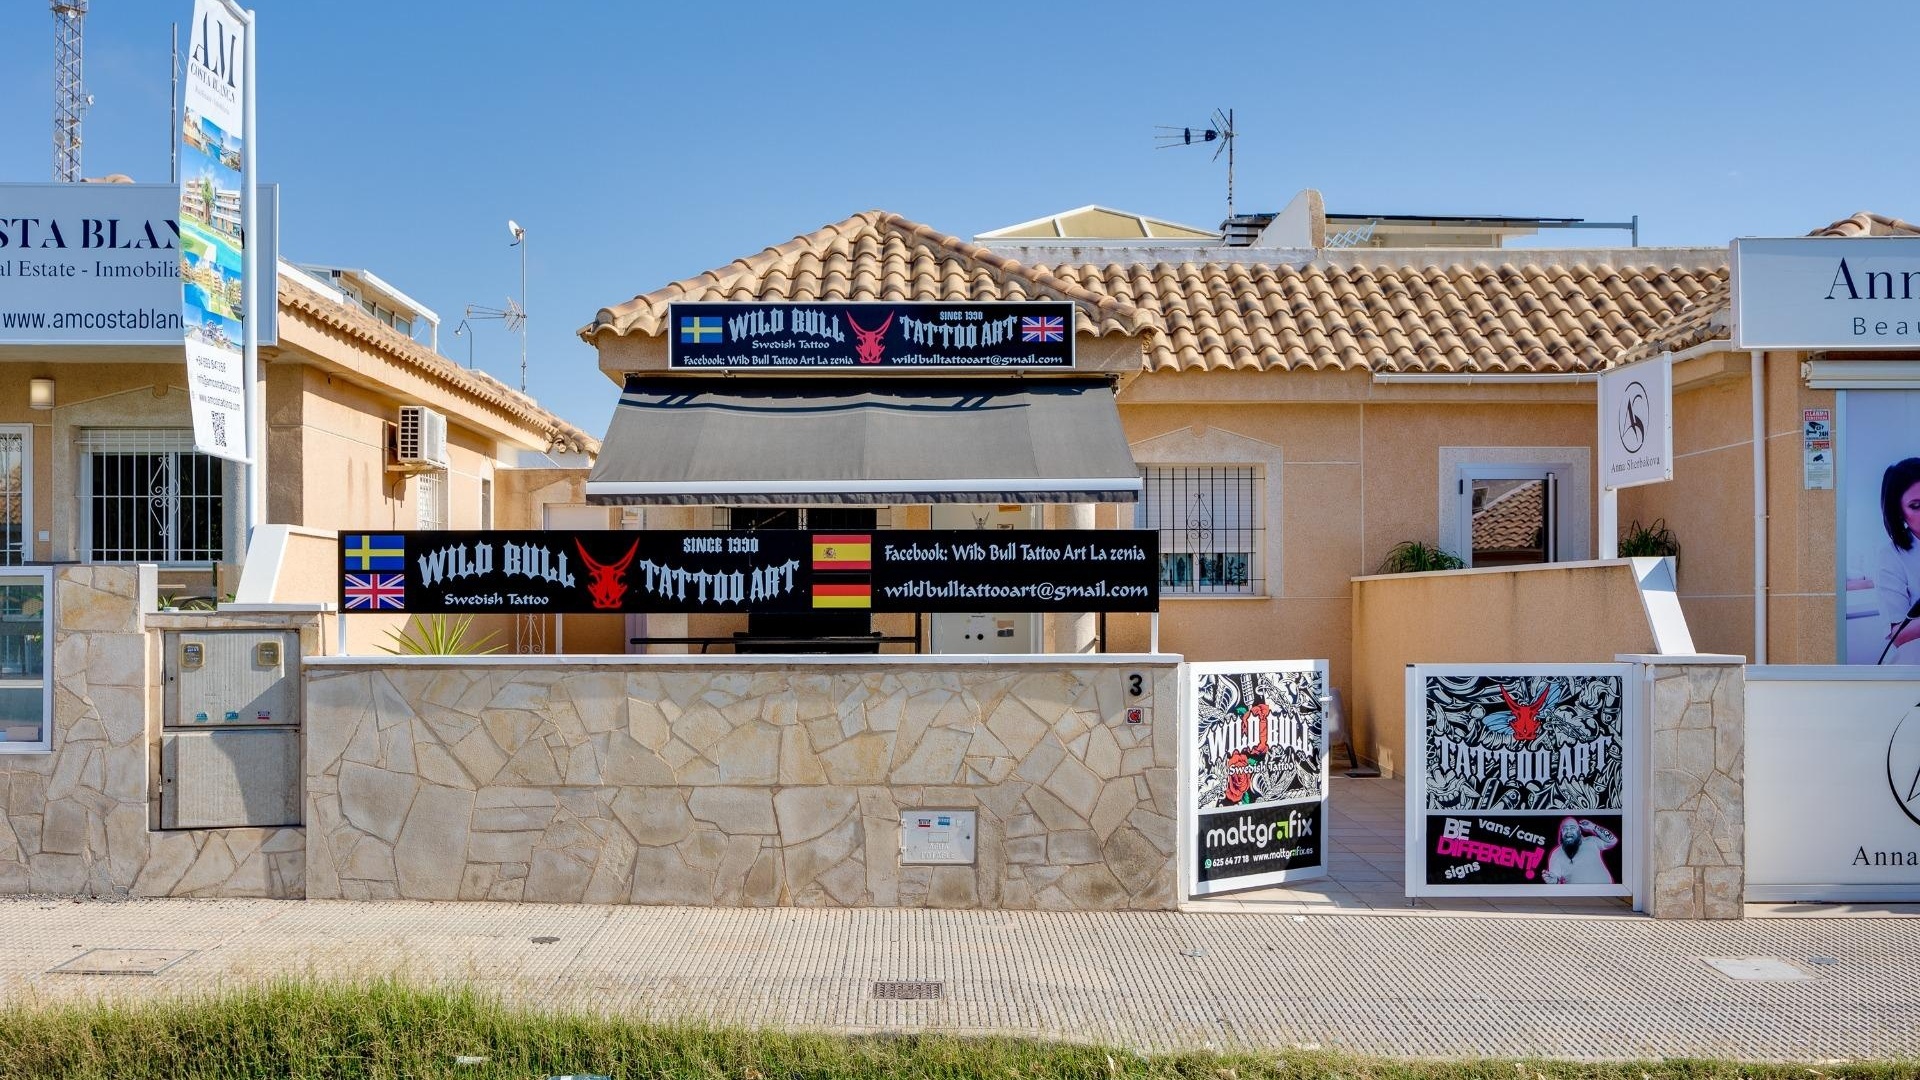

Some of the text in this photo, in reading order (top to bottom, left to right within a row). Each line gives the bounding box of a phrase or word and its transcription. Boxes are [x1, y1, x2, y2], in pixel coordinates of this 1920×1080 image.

[193, 12, 236, 88] AM
[191, 62, 211, 88] COSTA
[19, 260, 75, 277] Estate
[728, 306, 846, 343] WILD BULL
[940, 310, 963, 321] SINCE
[899, 314, 1018, 350] TATTOO ART
[1853, 317, 1920, 336] Bea
[752, 339, 830, 349] Swedish Tattoo
[683, 355, 854, 365] Facebook: Wild Bull Tattoo Art La zenia
[891, 354, 1063, 365] wildbulltattooart@gmail.com
[683, 537, 759, 554] SINCE 1990
[884, 542, 1146, 561] Facebook: Wild Bull Tattoo Art La zenia
[417, 539, 576, 589] WILD BULL
[639, 558, 800, 606] TATTOO ART
[884, 580, 1149, 601] wildbulltattooart@gmail.com
[444, 592, 549, 605] Swedish Tattoo
[1129, 674, 1143, 697] 3
[1207, 709, 1314, 766] WILD BULL
[1229, 761, 1294, 776] Swedish Tattoo
[1434, 734, 1614, 787] TATTOO ART
[1443, 817, 1472, 841] BE
[1478, 818, 1547, 846] vans/cars
[1212, 858, 1224, 867] 625
[1437, 836, 1546, 879] DIFFERENT!
[1852, 845, 1919, 866] Anna
[1444, 861, 1481, 879] signs
